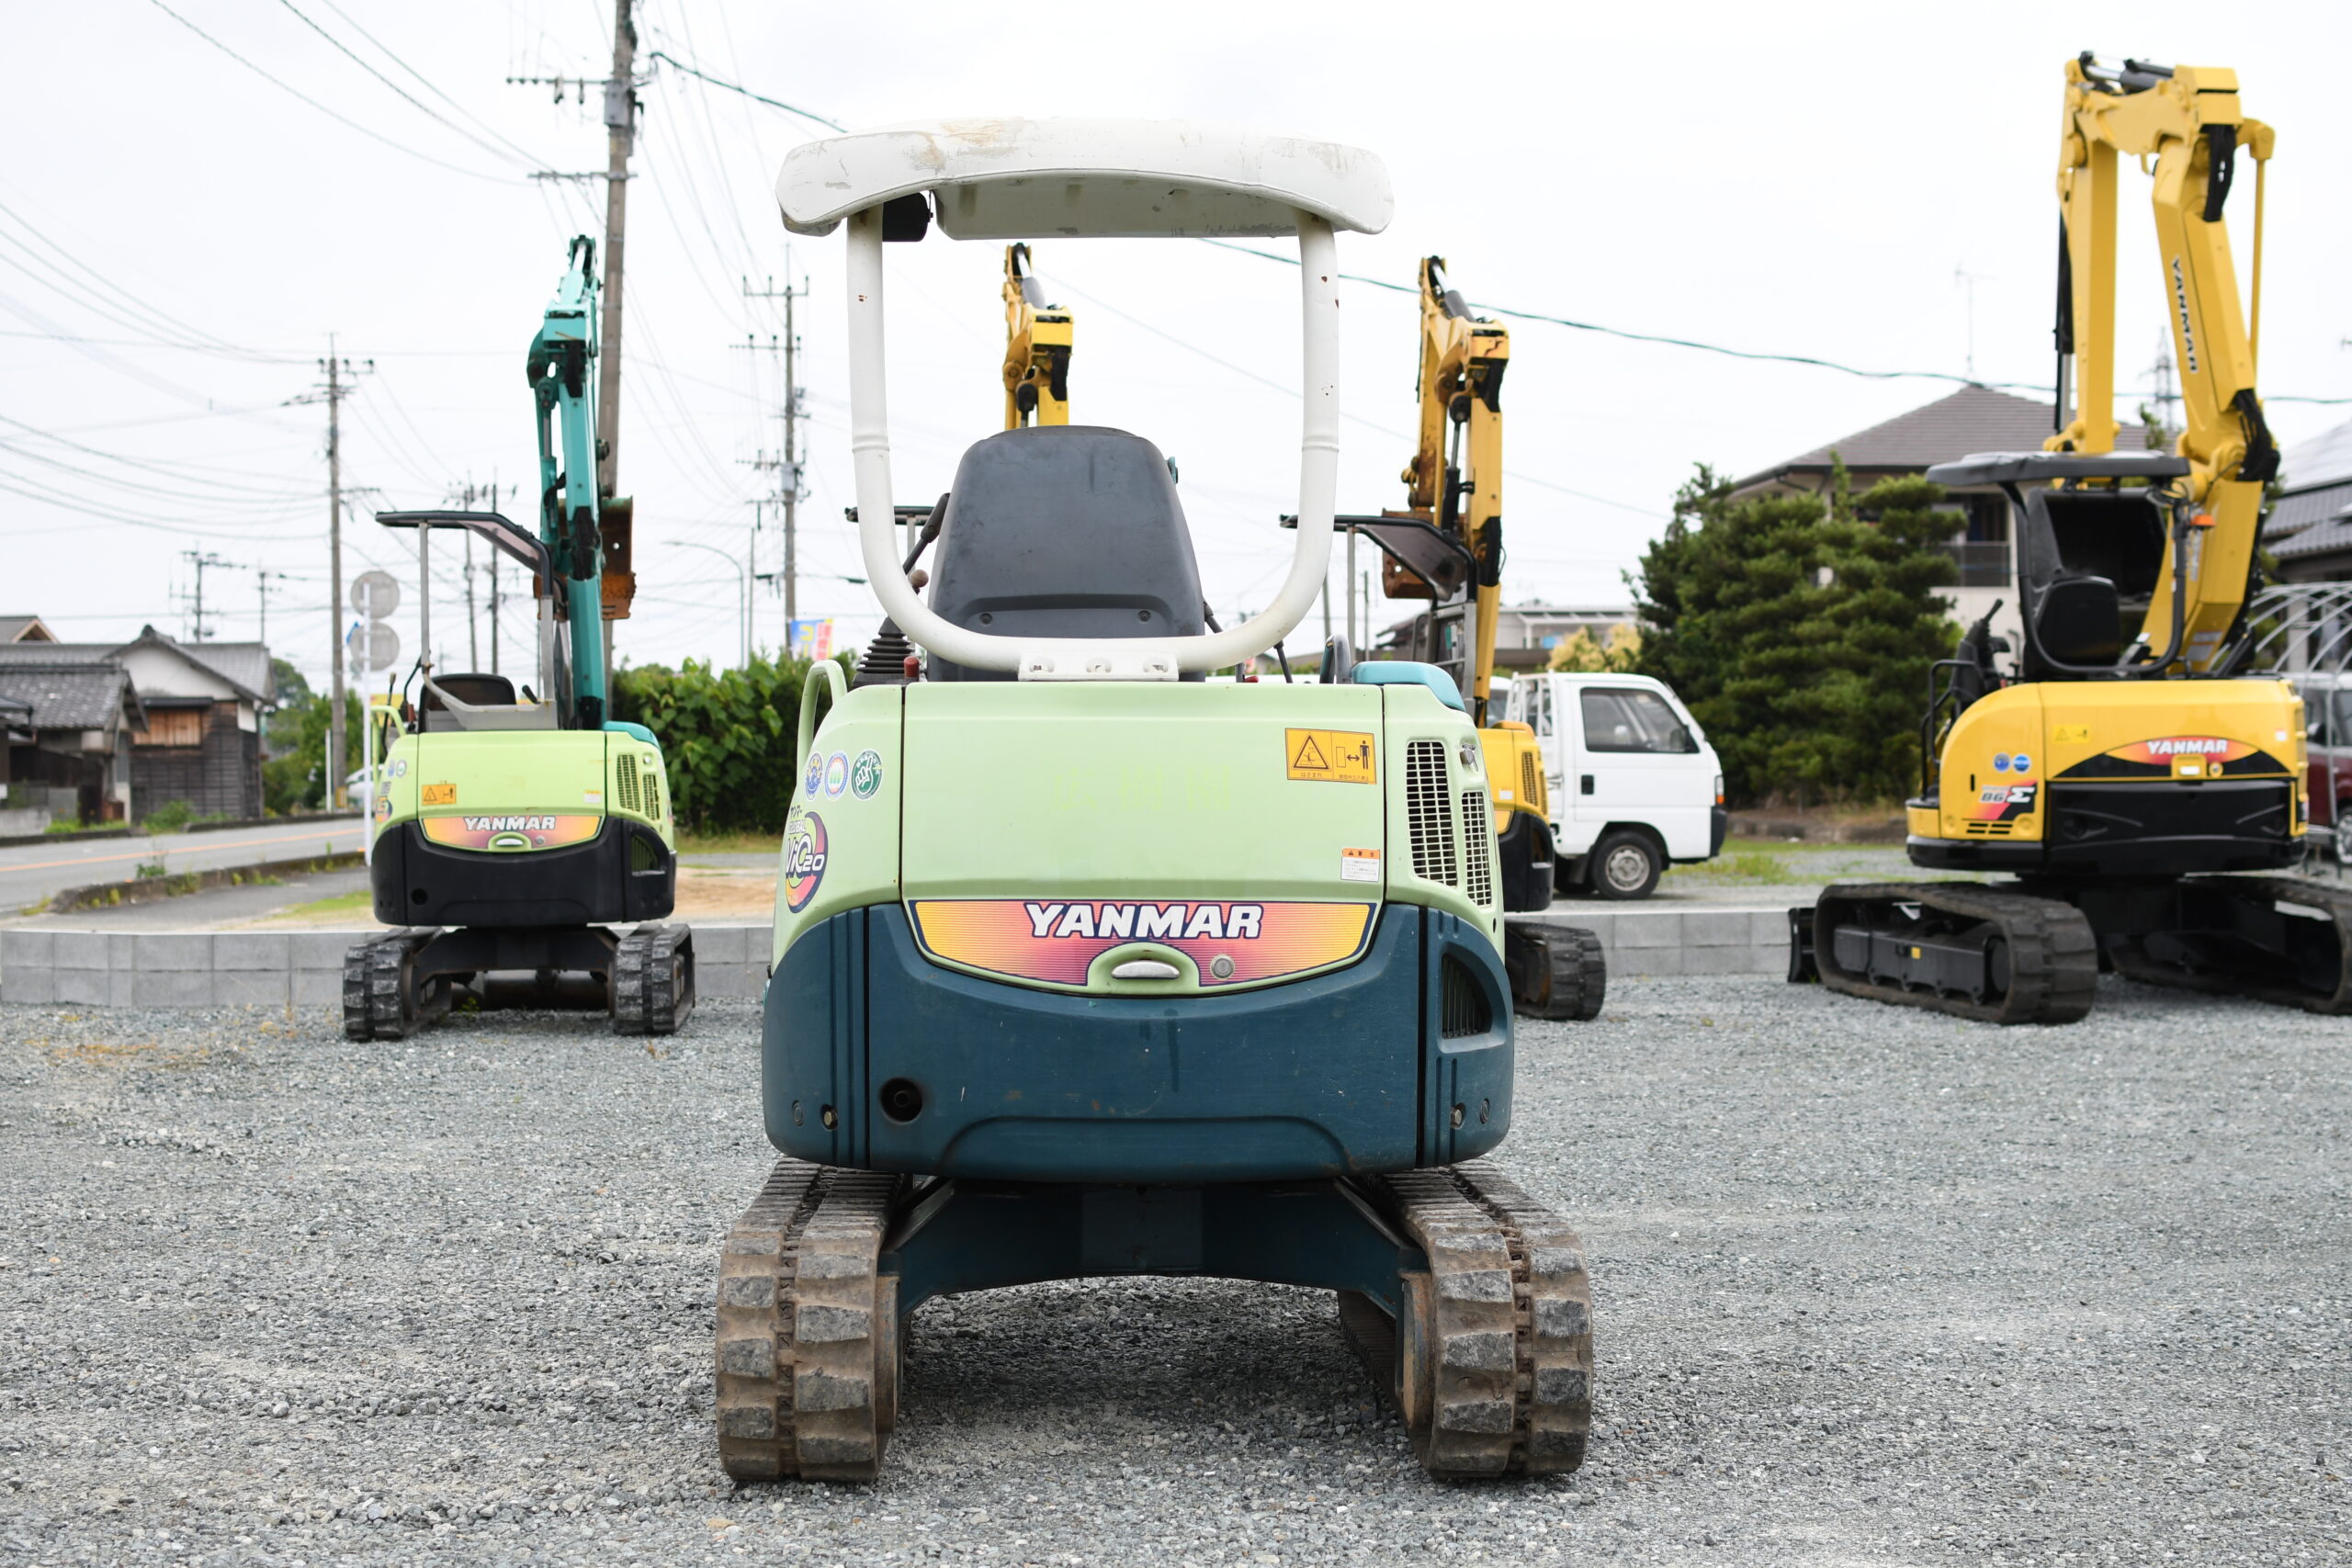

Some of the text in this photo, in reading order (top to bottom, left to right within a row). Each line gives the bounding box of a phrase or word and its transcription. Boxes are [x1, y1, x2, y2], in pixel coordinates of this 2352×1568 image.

[2172, 256, 2198, 372] YANMAR
[2146, 739, 2228, 755] YANMAR
[463, 815, 556, 831] YANMAR
[1023, 903, 1263, 939] YANMAR
